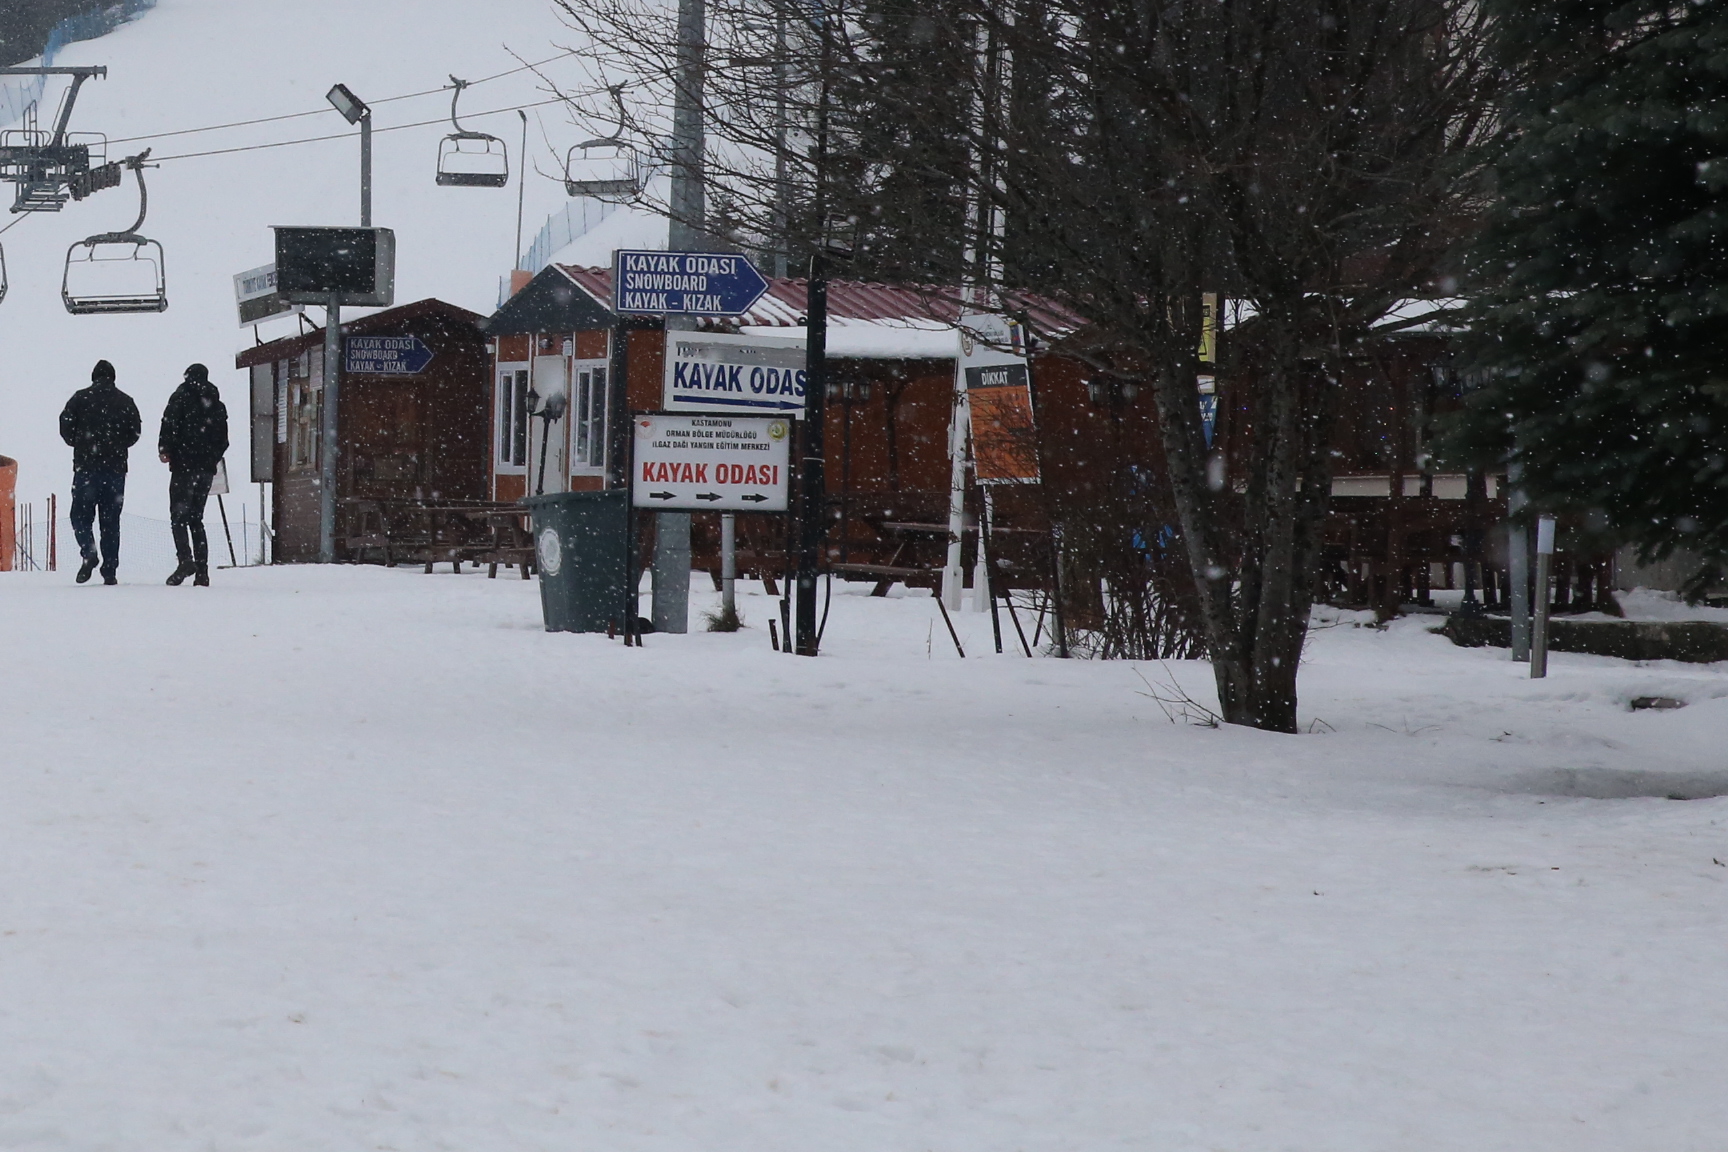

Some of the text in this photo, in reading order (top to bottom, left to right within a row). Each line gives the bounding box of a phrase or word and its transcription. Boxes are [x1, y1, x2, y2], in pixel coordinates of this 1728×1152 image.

[626, 255, 736, 275] KAYAK ODASI
[625, 273, 707, 291] SNOWBOARD
[625, 291, 668, 309] KAYAK
[683, 293, 722, 311] KIZAK
[351, 338, 415, 350] KAYAK ODASI
[350, 349, 399, 361] SNOWBOARD
[350, 360, 408, 372] KAYAK KIZAK
[673, 361, 807, 397] KAYAK ODAS
[981, 370, 1008, 385] DİKKAT
[691, 419, 733, 428] KASTAMONU
[666, 429, 758, 440] ORMAN BÖLGE MÜDÜRLÜĞÜ
[672, 440, 689, 449] DAĞI
[690, 441, 714, 449] YANGIN
[715, 441, 740, 450] EĞİTİM
[741, 442, 771, 451] MERKEZİ
[642, 461, 779, 485] KAYAK ODASI
